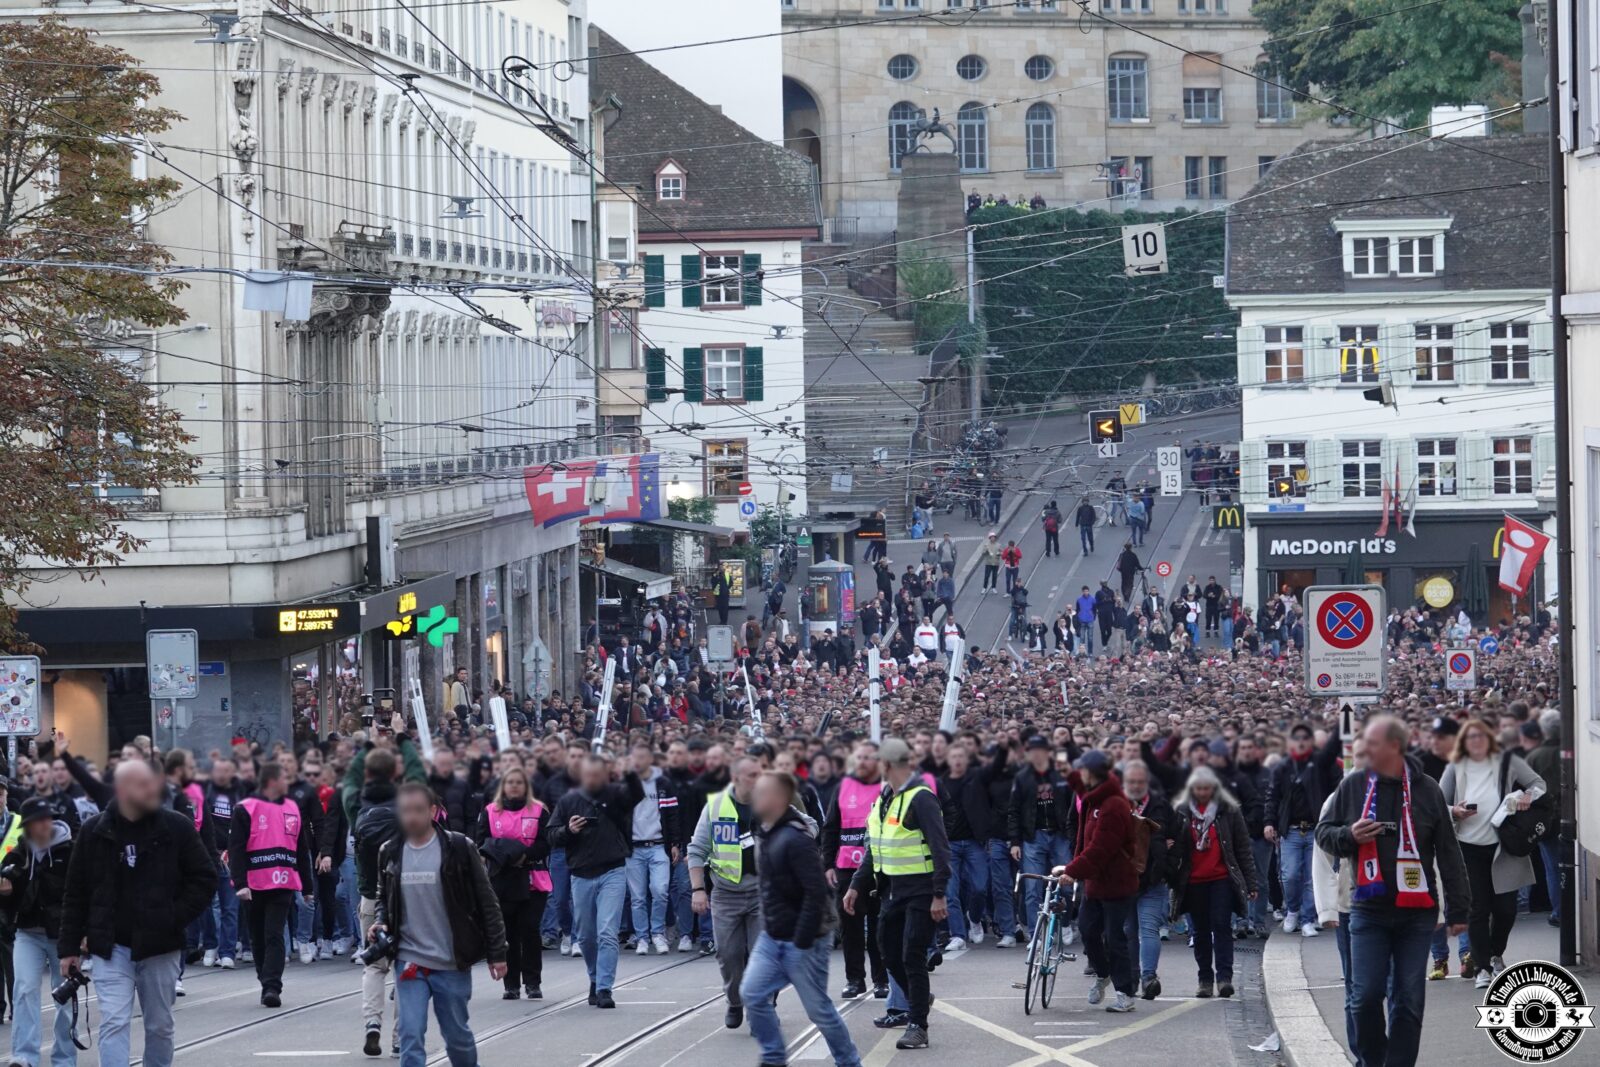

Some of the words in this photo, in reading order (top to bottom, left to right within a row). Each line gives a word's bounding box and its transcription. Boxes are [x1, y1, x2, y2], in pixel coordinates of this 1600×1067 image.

[1131, 231, 1158, 258] 10
[1160, 452, 1178, 467] 30
[1165, 475, 1178, 488] 15
[800, 527, 809, 537] A
[713, 824, 739, 842] POL
[272, 870, 289, 884] 06
